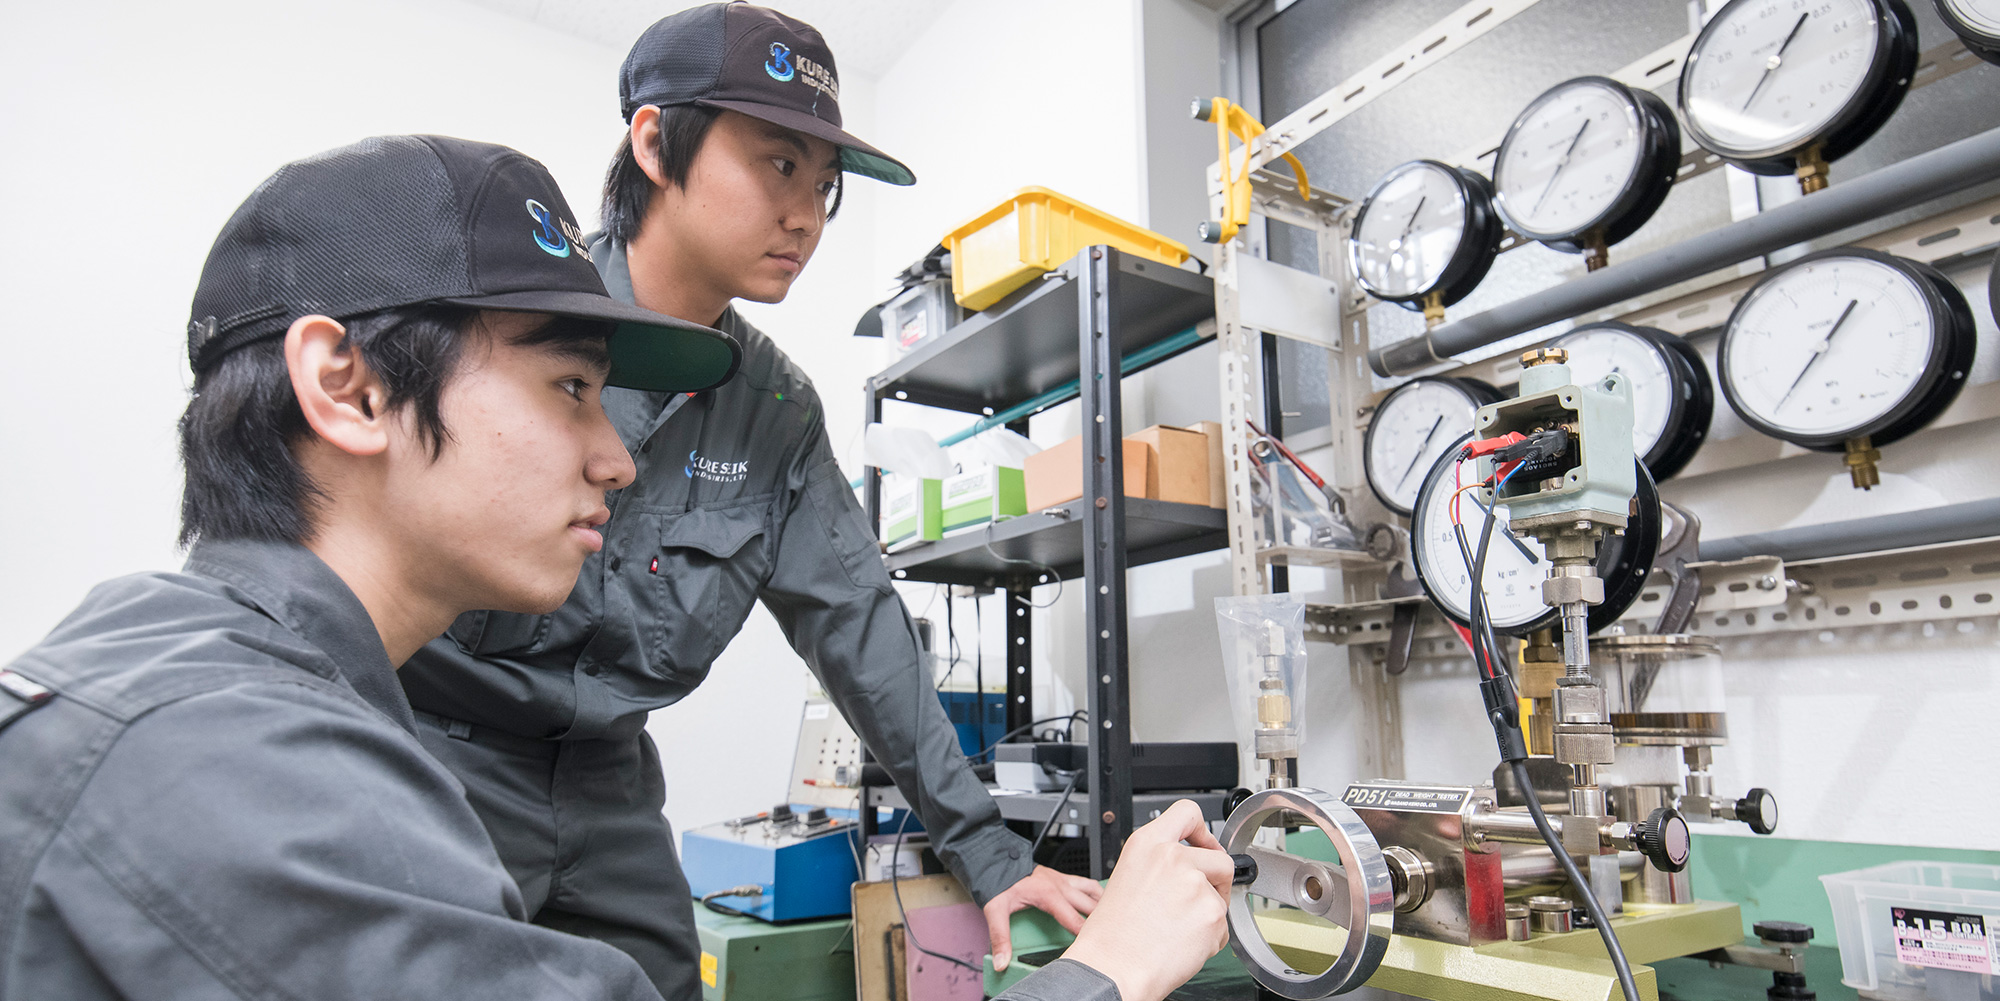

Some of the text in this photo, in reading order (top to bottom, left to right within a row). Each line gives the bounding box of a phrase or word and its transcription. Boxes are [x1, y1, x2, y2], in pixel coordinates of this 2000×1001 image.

[796, 54, 831, 85] KURE
[559, 216, 589, 250] KUR
[1442, 531, 1453, 543] 0.5
[1461, 574, 1466, 585] 0
[1344, 788, 1388, 805] PD51
[1951, 921, 1985, 941] BOX
